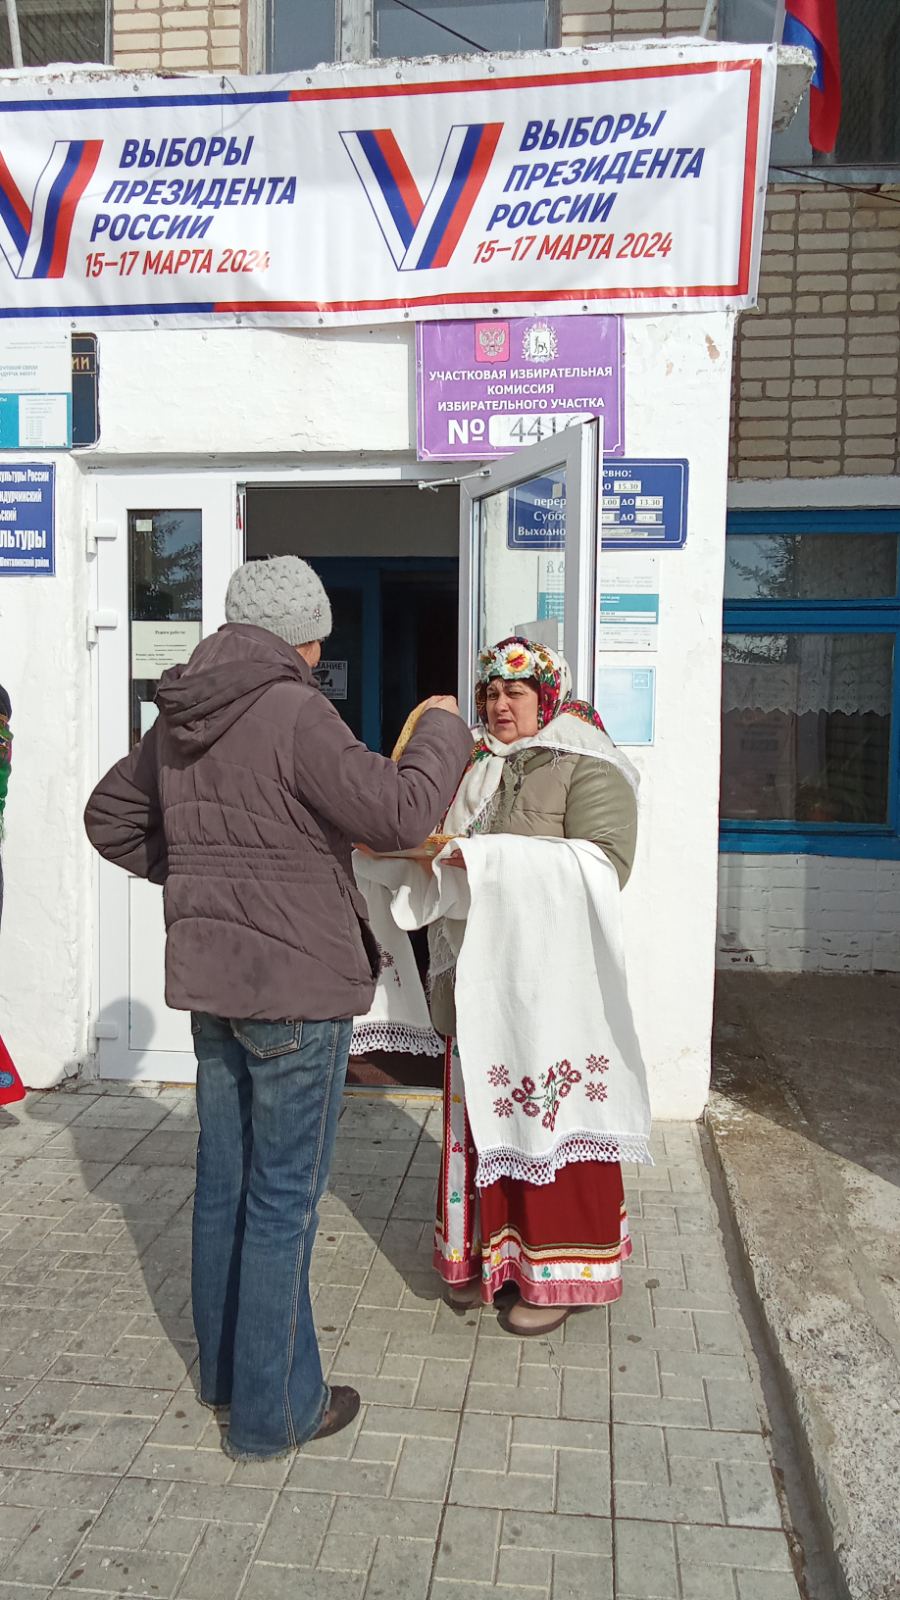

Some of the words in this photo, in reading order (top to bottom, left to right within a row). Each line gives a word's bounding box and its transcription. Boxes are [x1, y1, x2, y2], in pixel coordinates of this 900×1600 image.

[519, 110, 667, 152] ВЫБОРЫ
[118, 135, 255, 169] ВЫБОРЫ
[502, 147, 706, 193] ПРЕЗИДЕНТА
[102, 176, 297, 210] ПРЕЗИДЕНТА
[486, 192, 618, 232] РОССИИ
[90, 213, 215, 243] РОССИИ
[536, 234, 616, 261] МАРТА
[616, 232, 673, 259] 2024
[142, 249, 215, 276] МАРТА
[216, 249, 270, 274] 2024
[72, 356, 90, 370] ИИ
[429, 369, 507, 382] УЧАСТКОВАЯ
[510, 366, 613, 380] ИЗБИРАТЕЛЬНАЯ
[487, 384, 555, 395] КОМИССИЯ
[438, 399, 548, 412] ИЗБИРАТЕЛЬНОГО
[551, 397, 605, 410] УЧАСТКА
[448, 418, 485, 445] №
[602, 469, 632, 478] евно:
[534, 498, 567, 509] перер
[0, 529, 47, 551] льтуры
[518, 526, 566, 536] Выходно
